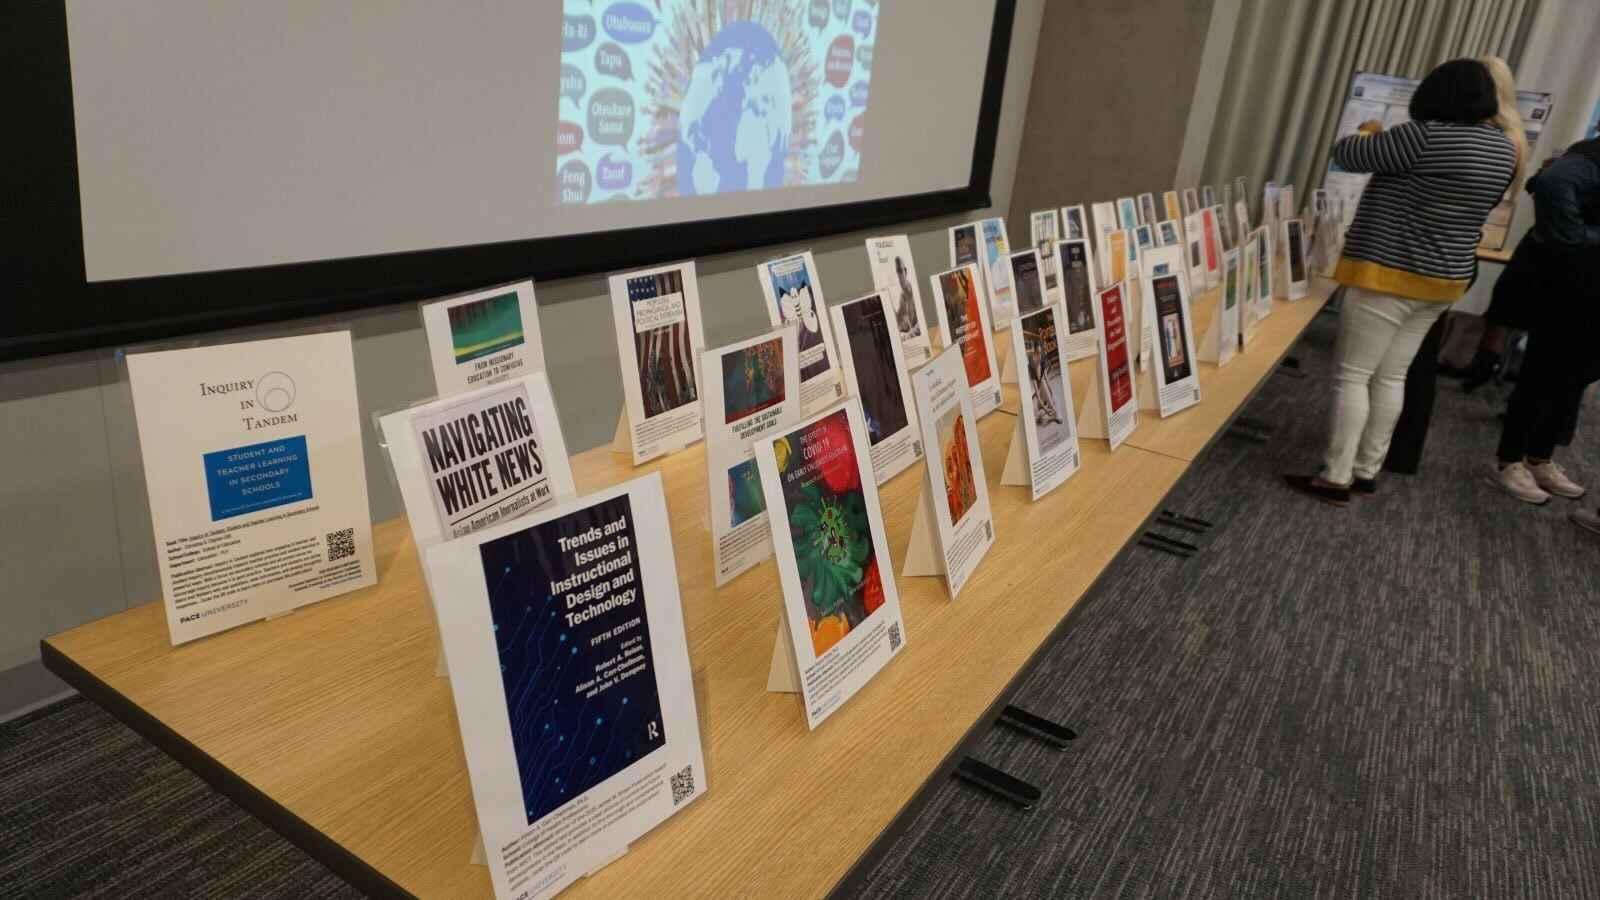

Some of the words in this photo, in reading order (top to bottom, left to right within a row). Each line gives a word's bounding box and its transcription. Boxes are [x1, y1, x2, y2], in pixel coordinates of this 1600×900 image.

[467, 370, 492, 384] EDUCATION
[493, 366, 499, 376] TO
[422, 397, 534, 474] NAVIGATING
[740, 423, 766, 440] DEVELOPMENT
[227, 449, 265, 462] STUDENT
[268, 446, 286, 454] AND
[803, 436, 830, 460] COVID-19
[217, 462, 256, 476] TEACHER
[259, 454, 298, 469] LEARNING
[787, 473, 795, 483] ON
[795, 467, 807, 479] EARLY
[229, 479, 239, 487] IN
[241, 468, 289, 484] SECONDARY
[241, 481, 281, 496] SCHOOLS
[436, 459, 498, 516] WHITE
[495, 439, 543, 490] NEWS
[470, 510, 500, 531] American
[500, 494, 530, 518] Journalists
[536, 484, 550, 501] Work
[558, 525, 602, 553] Trends
[604, 516, 626, 538] and
[574, 544, 616, 566] Issues
[616, 536, 630, 552] in
[550, 553, 632, 596] Instructional
[566, 579, 611, 609] Design
[612, 568, 635, 591] and
[180, 613, 200, 624] PACE
[201, 600, 248, 618] UNIVERSITY
[565, 588, 637, 627] Technology
[591, 629, 612, 647] FIFTH
[613, 616, 641, 638] EDITION
[620, 637, 635, 649] Edited
[595, 658, 616, 673] Robert
[616, 653, 624, 664] A.
[575, 681, 595, 695] Alison
[595, 676, 603, 687] A.
[586, 687, 598, 699] and
[599, 680, 613, 694] John
[620, 662, 646, 682] Dempsey
